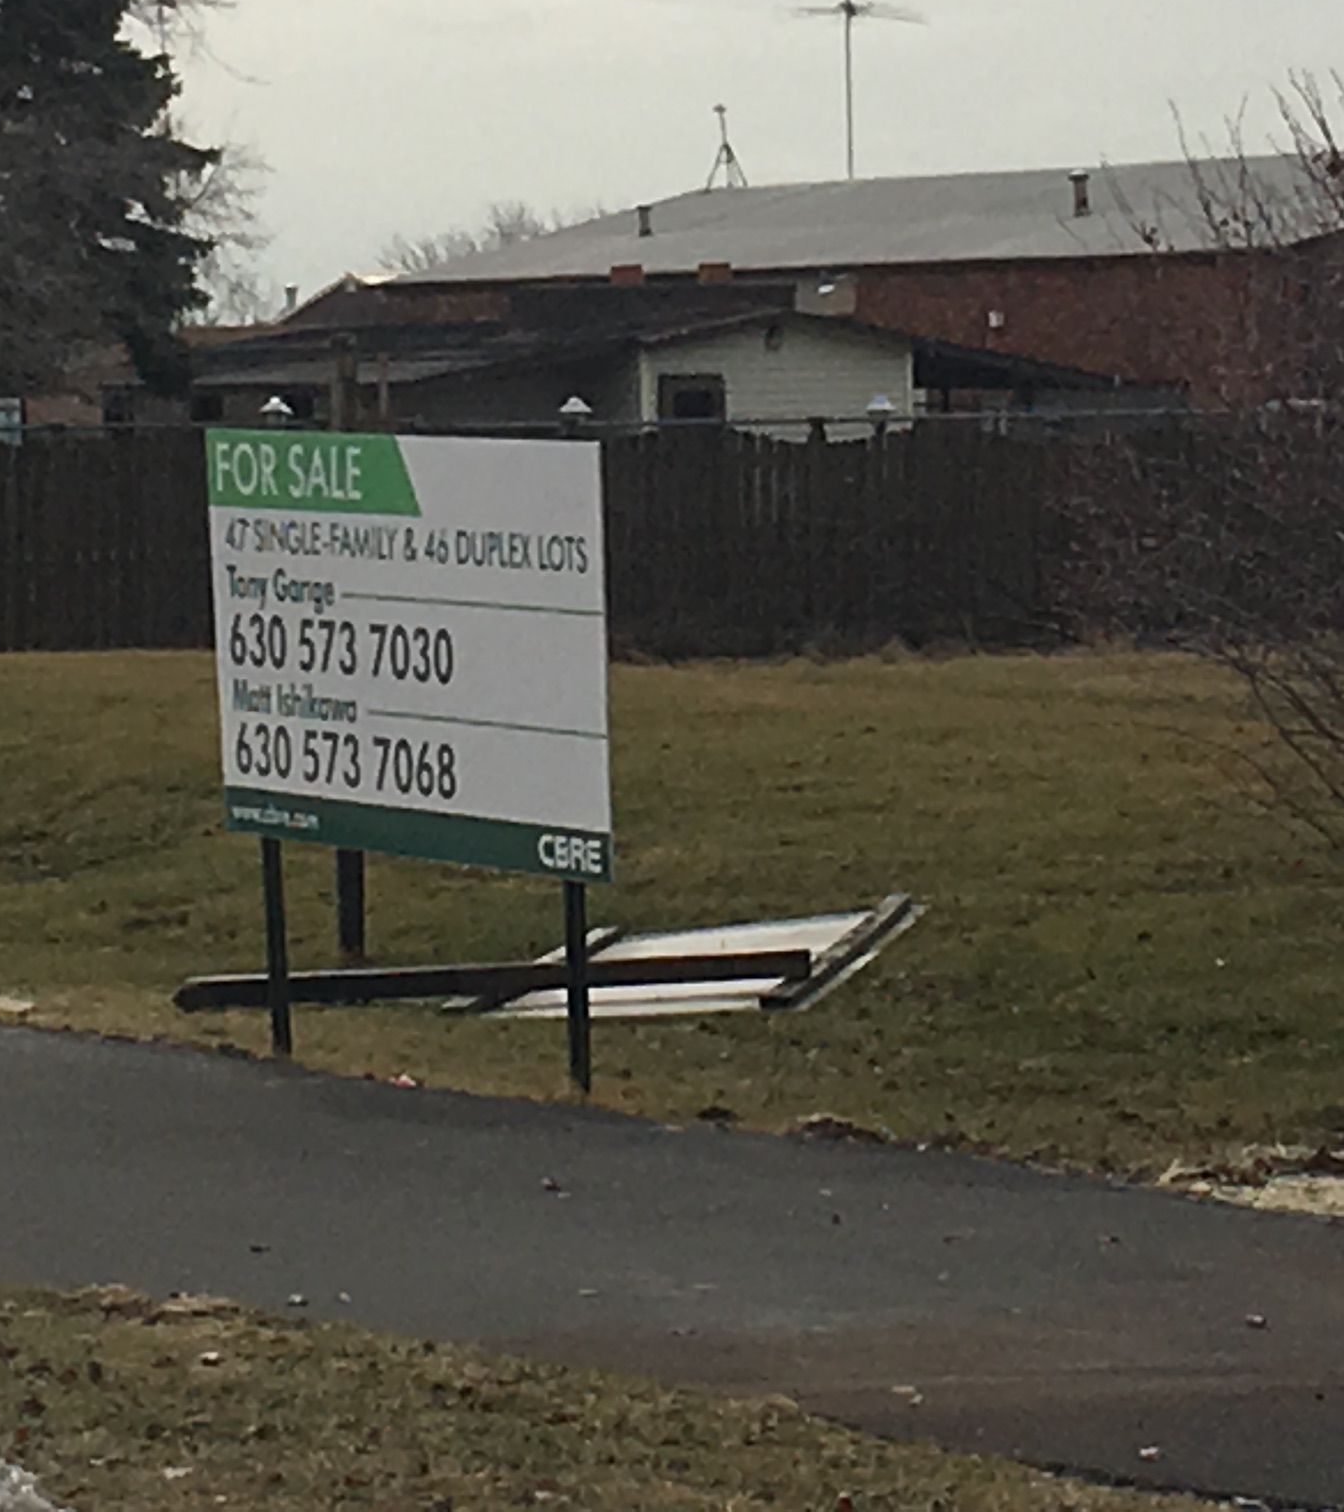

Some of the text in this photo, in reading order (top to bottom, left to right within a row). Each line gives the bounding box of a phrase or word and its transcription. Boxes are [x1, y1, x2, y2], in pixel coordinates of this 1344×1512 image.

[215, 442, 362, 500] FOR SALE
[225, 518, 588, 574] 47 SINGLE-FAMILY & 46 DUPLEX LOTS
[226, 564, 268, 610] Tony
[230, 613, 454, 685] 630 573 7030
[233, 678, 272, 715] Matt
[236, 721, 457, 800] 630 573 7068
[537, 834, 603, 874] CBRE
